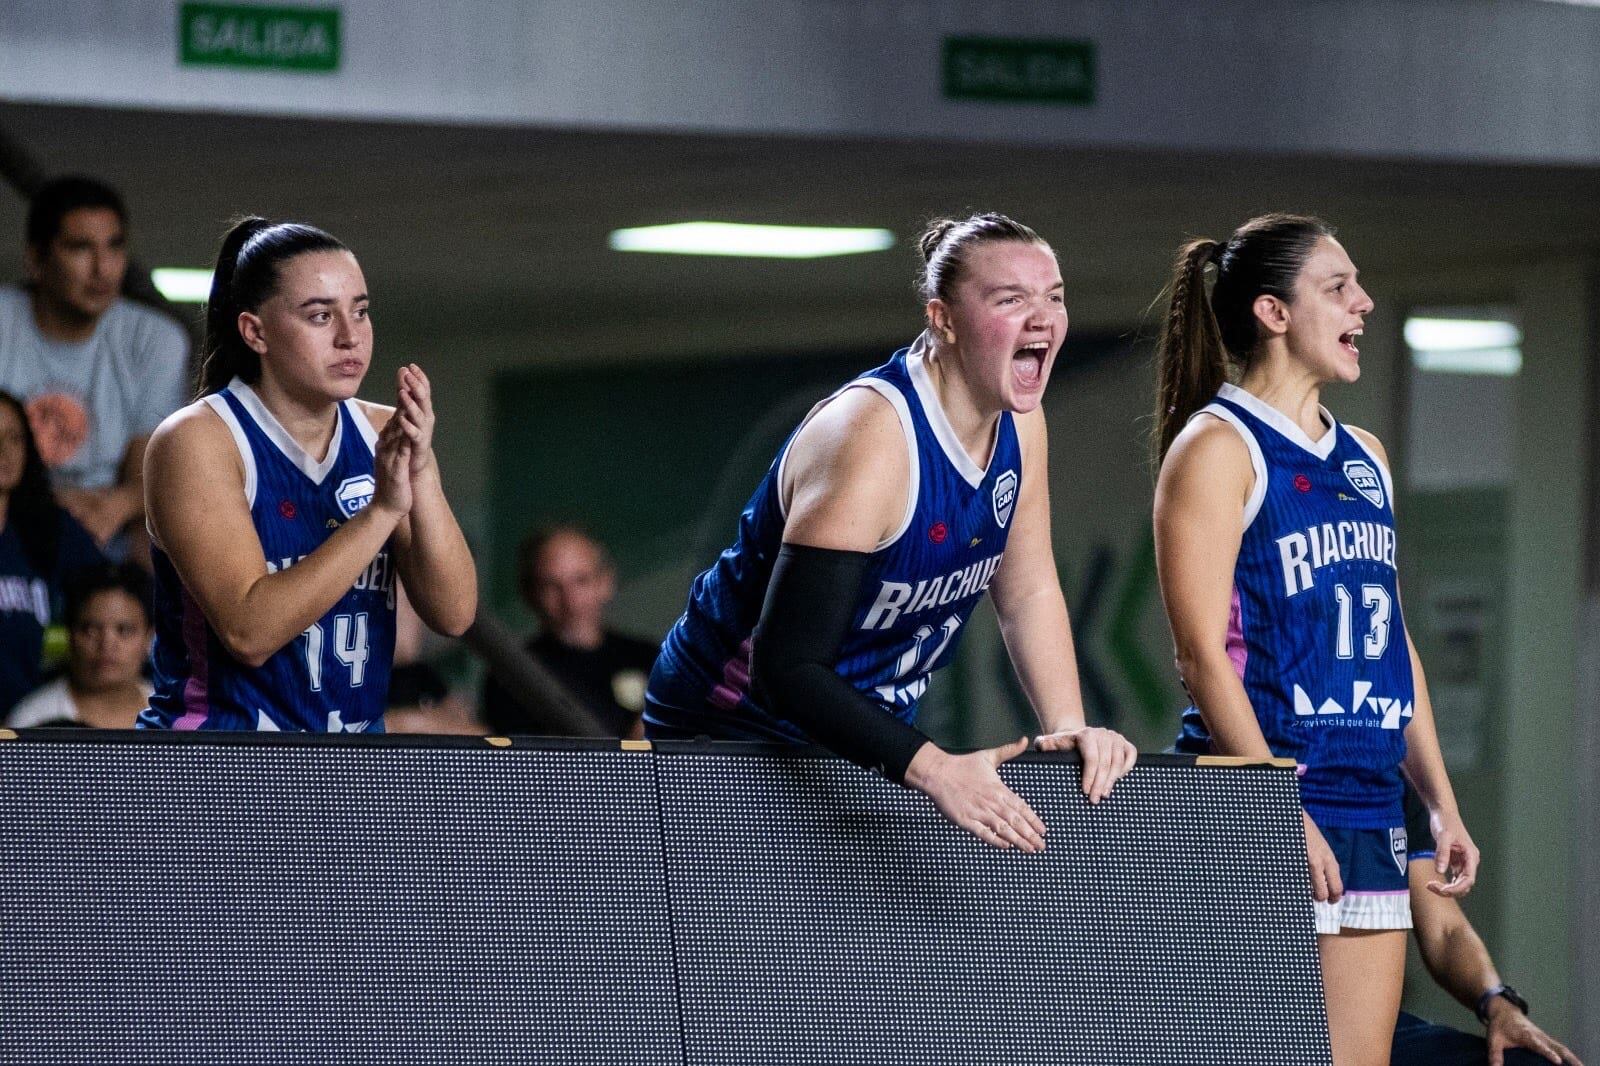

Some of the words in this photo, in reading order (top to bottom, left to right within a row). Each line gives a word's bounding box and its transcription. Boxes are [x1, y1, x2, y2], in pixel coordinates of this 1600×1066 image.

[189, 13, 328, 56] SALIDA
[997, 490, 1013, 509] CAR
[1354, 477, 1378, 489] CAR
[860, 552, 1004, 630] RIACHUE
[1274, 520, 1397, 598] RIACHUEL
[301, 612, 370, 692] 14
[892, 613, 963, 681] 11
[1335, 583, 1392, 660] 13
[1291, 717, 1345, 728] provincia
[1347, 719, 1363, 728] que
[1365, 718, 1380, 728] late
